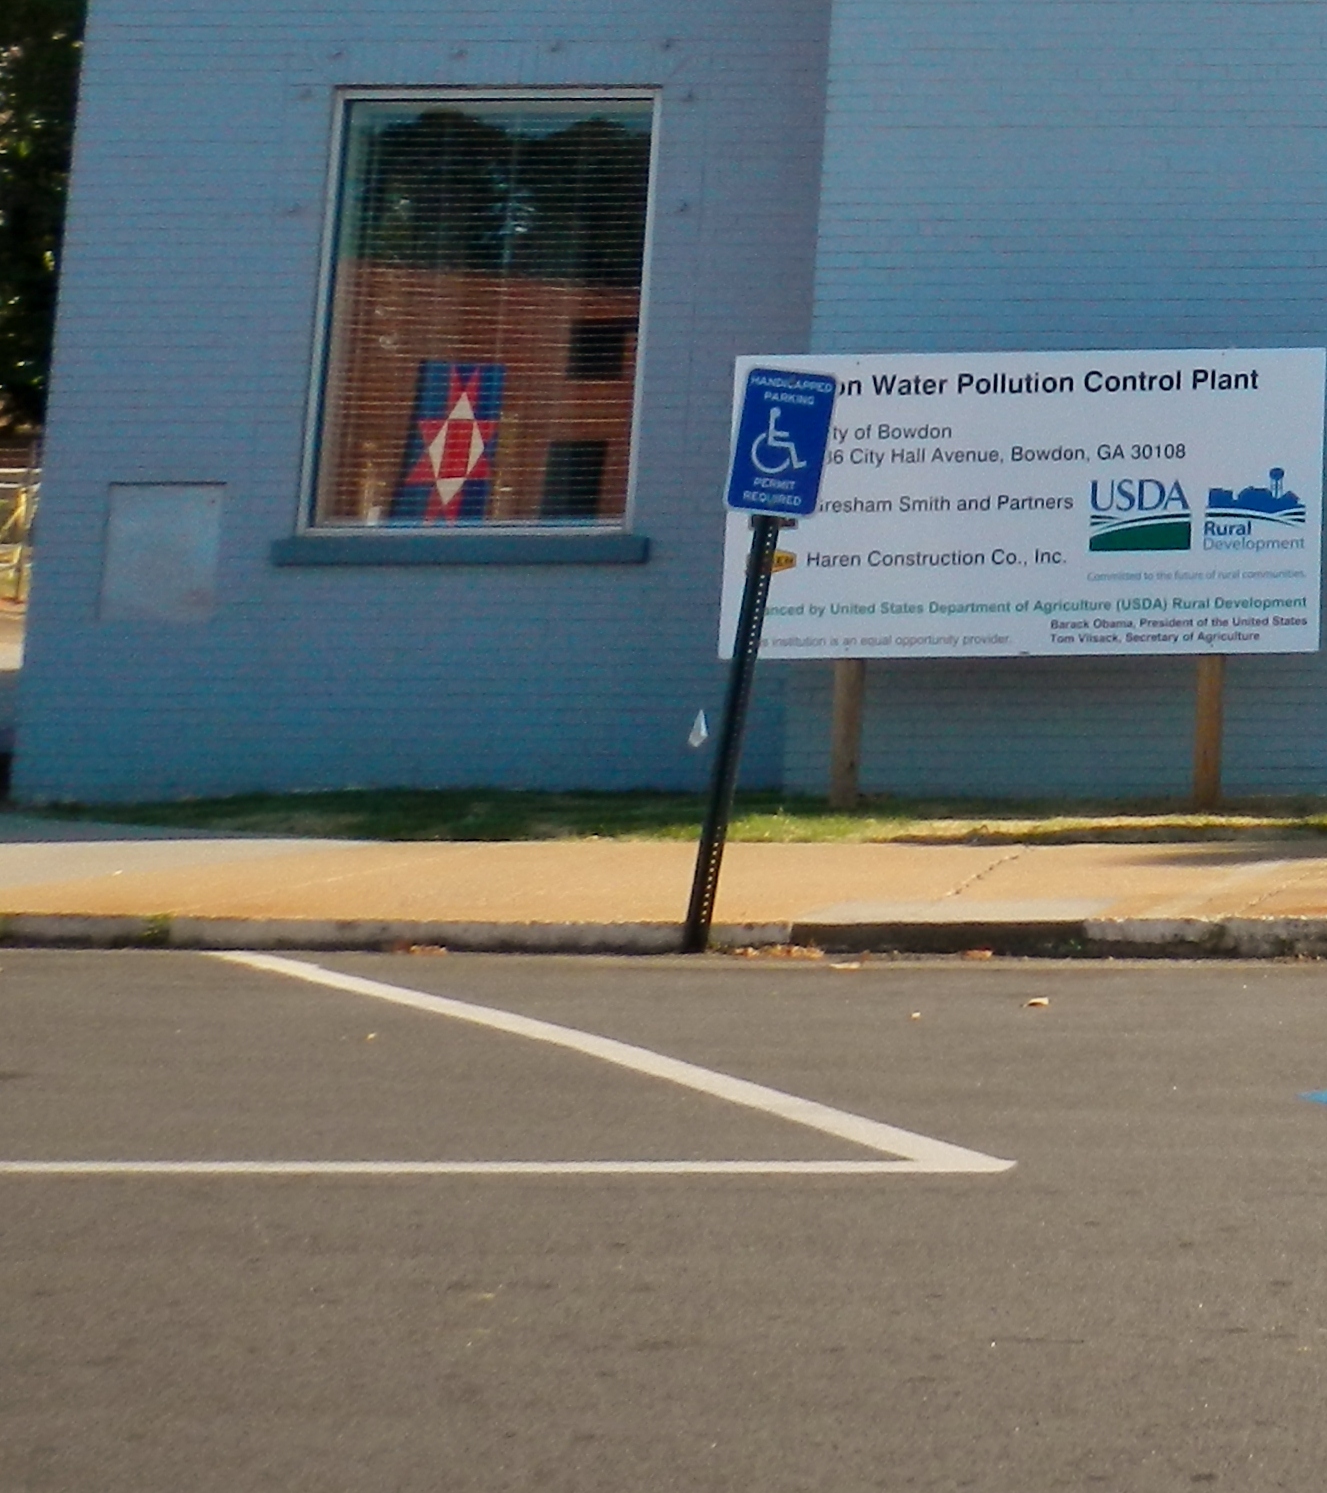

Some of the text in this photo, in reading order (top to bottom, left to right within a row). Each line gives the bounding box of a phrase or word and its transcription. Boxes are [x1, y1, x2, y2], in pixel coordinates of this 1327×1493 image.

[872, 374, 948, 396] Water
[957, 371, 1074, 395] Pollution
[1084, 370, 1182, 393] Control
[1192, 369, 1259, 390] Plant
[764, 391, 815, 405] PARKING
[854, 424, 872, 440] of
[878, 424, 952, 440] Bowdon
[850, 447, 885, 468] City
[891, 447, 926, 464] Hall
[931, 446, 1004, 464] Avenue,
[1011, 445, 1091, 463] Bowdon,
[1097, 444, 1125, 461] GA
[1130, 443, 1186, 459] 30108
[753, 477, 796, 489] PERMIT
[819, 494, 1074, 514] resham Smith and Partners
[1091, 479, 1190, 512] USDA
[1204, 520, 1251, 537] Rural
[1203, 537, 1306, 552] Development
[806, 552, 862, 567] Haren
[867, 549, 986, 567] Construction
[991, 549, 1028, 567] Co.,
[1035, 549, 1067, 565] Inc.
[809, 603, 826, 618] by
[830, 602, 876, 615] United
[880, 601, 924, 615] States
[928, 600, 1011, 616] Department
[1015, 600, 1029, 613] of
[1033, 599, 1112, 615] Agriculture
[1116, 598, 1168, 613] (USDA)
[1172, 597, 1210, 611] Rural
[1214, 596, 1308, 612] Development
[1050, 618, 1089, 630] Barack
[1139, 617, 1194, 629] President
[1197, 616, 1209, 628] of
[1211, 616, 1229, 628] the
[1232, 615, 1270, 627] United
[1272, 615, 1308, 627] States
[1050, 632, 1075, 644] Tom
[1126, 630, 1179, 644] Secretary
[1182, 630, 1194, 642] of
[1197, 629, 1260, 644] Agriculture
